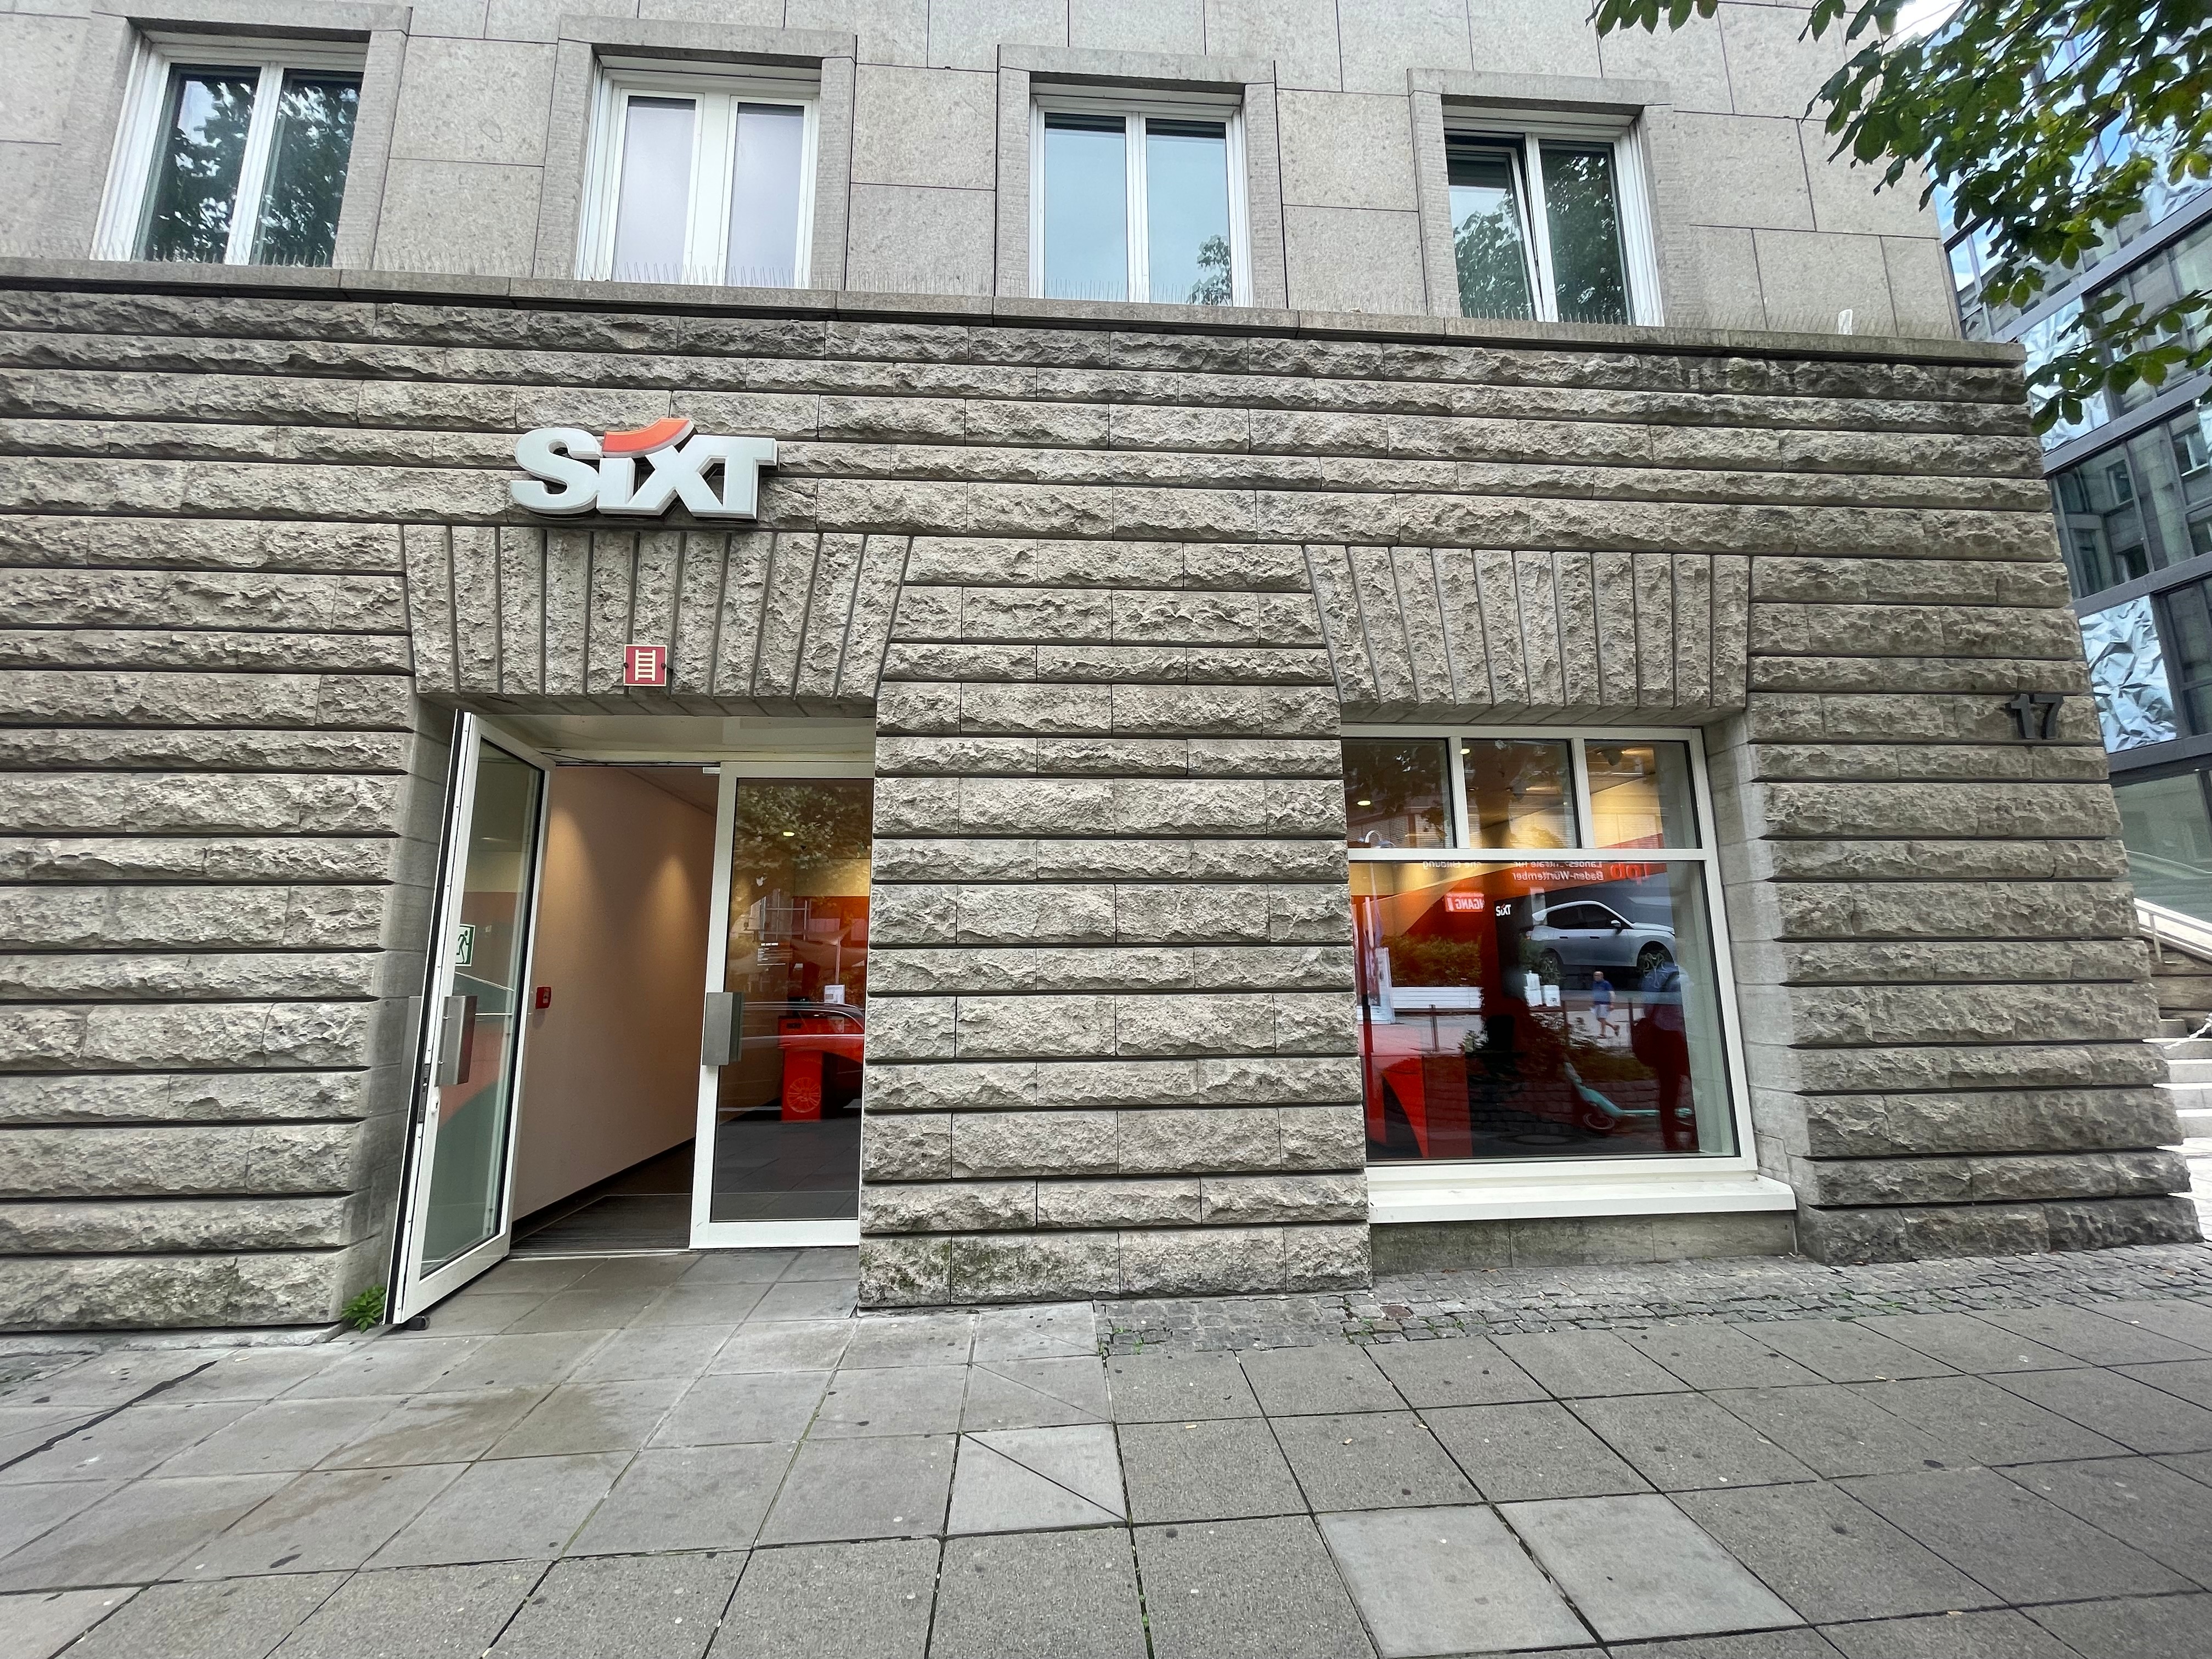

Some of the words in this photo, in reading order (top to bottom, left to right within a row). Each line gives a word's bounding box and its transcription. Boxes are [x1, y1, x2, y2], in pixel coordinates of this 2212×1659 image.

[510, 417, 778, 521] SIXT
[2010, 693, 2063, 739] 17
[1496, 903, 1511, 916] SIXT
